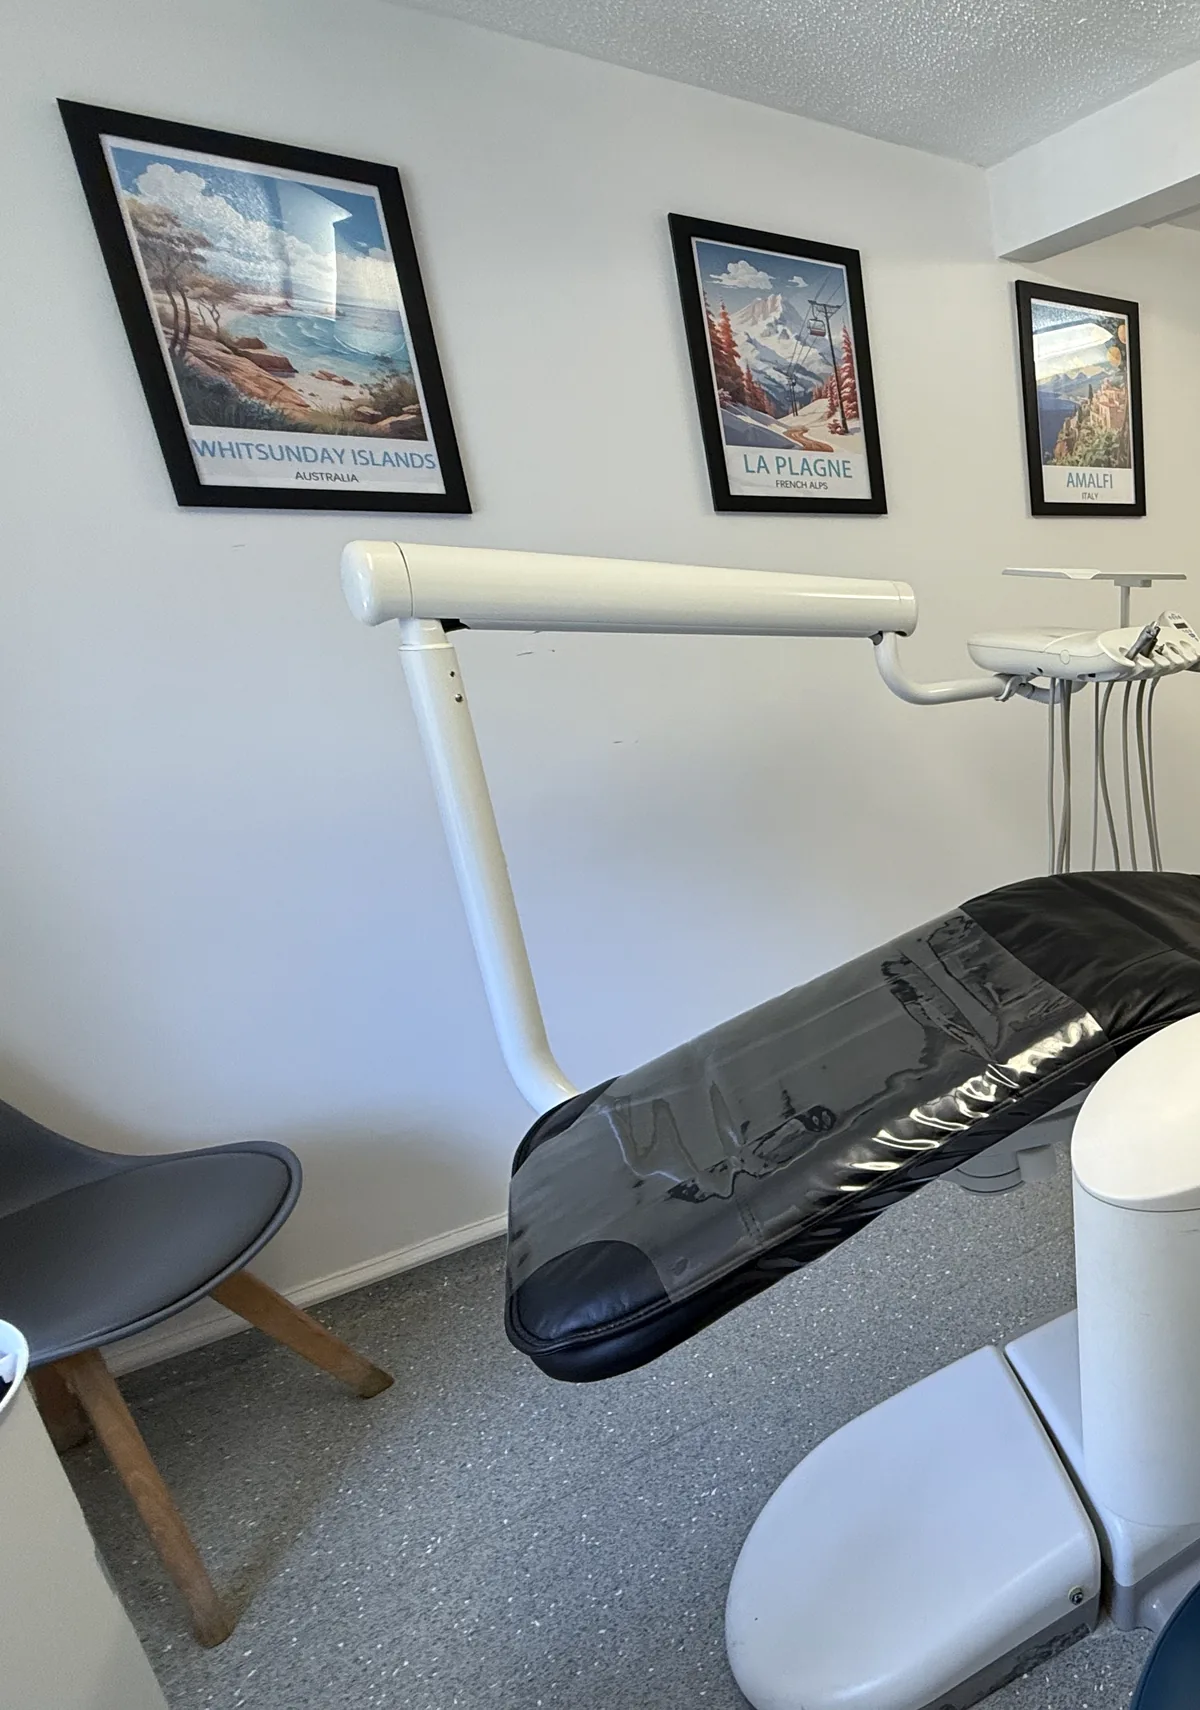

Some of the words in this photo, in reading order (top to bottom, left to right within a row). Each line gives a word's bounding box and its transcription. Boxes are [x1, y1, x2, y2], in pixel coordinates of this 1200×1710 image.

[191, 439, 345, 465] WHITSUNDAY
[352, 448, 436, 470] ISLANDS
[744, 454, 770, 474] LA
[775, 455, 853, 479] PLAGNE
[295, 471, 359, 483] AUSTRALIA
[1066, 472, 1113, 490] AMALFI
[775, 480, 808, 490] FRENCH
[809, 481, 829, 491] ALPS
[1081, 492, 1099, 500] ITALY
